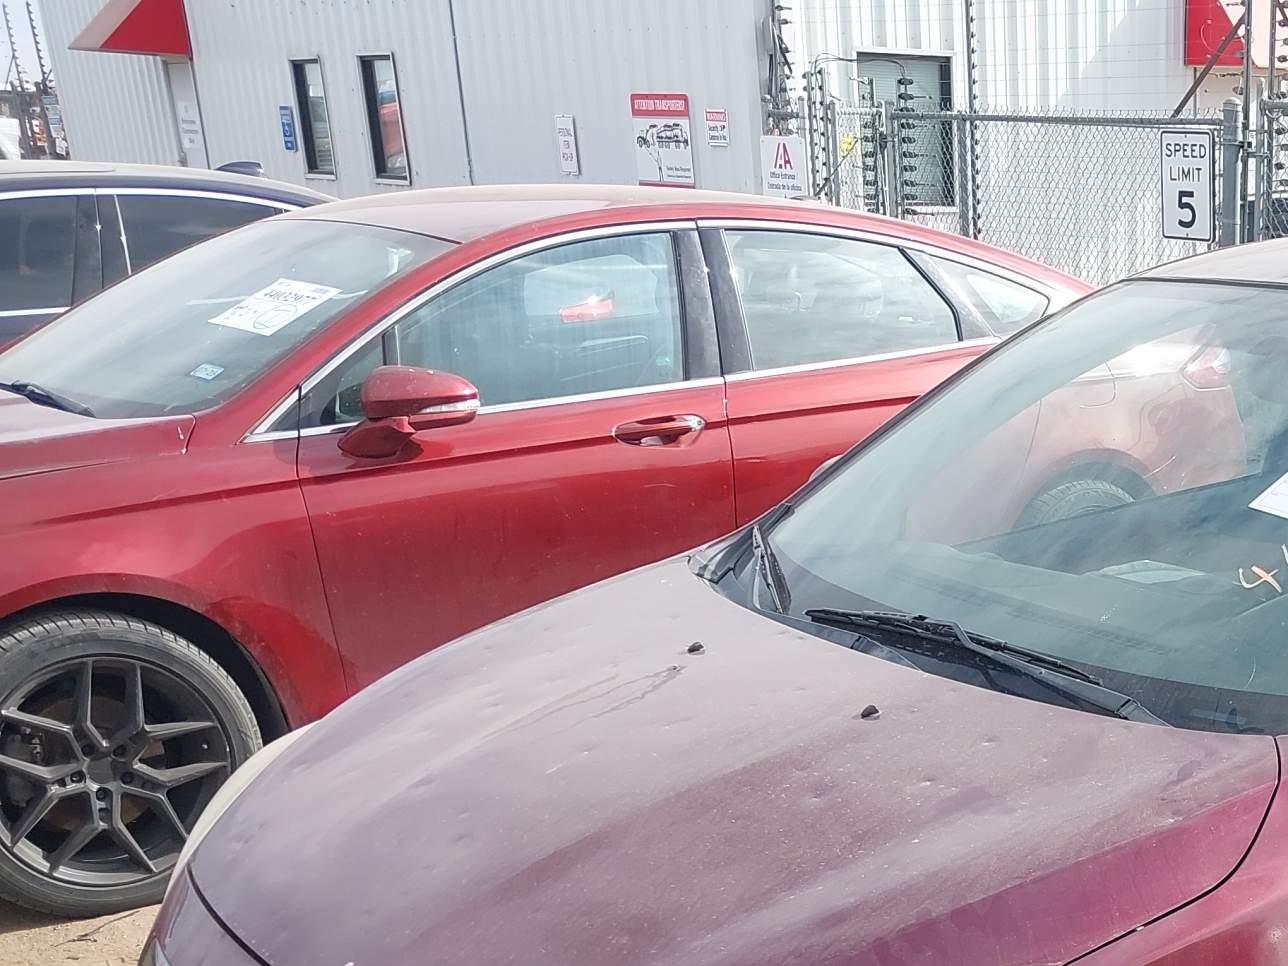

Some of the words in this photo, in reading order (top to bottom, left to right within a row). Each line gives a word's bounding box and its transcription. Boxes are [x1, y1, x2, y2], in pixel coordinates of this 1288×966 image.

[1165, 143, 1207, 159] SPEED
[1169, 166, 1202, 182] LIMIT
[1178, 190, 1196, 228] 5
